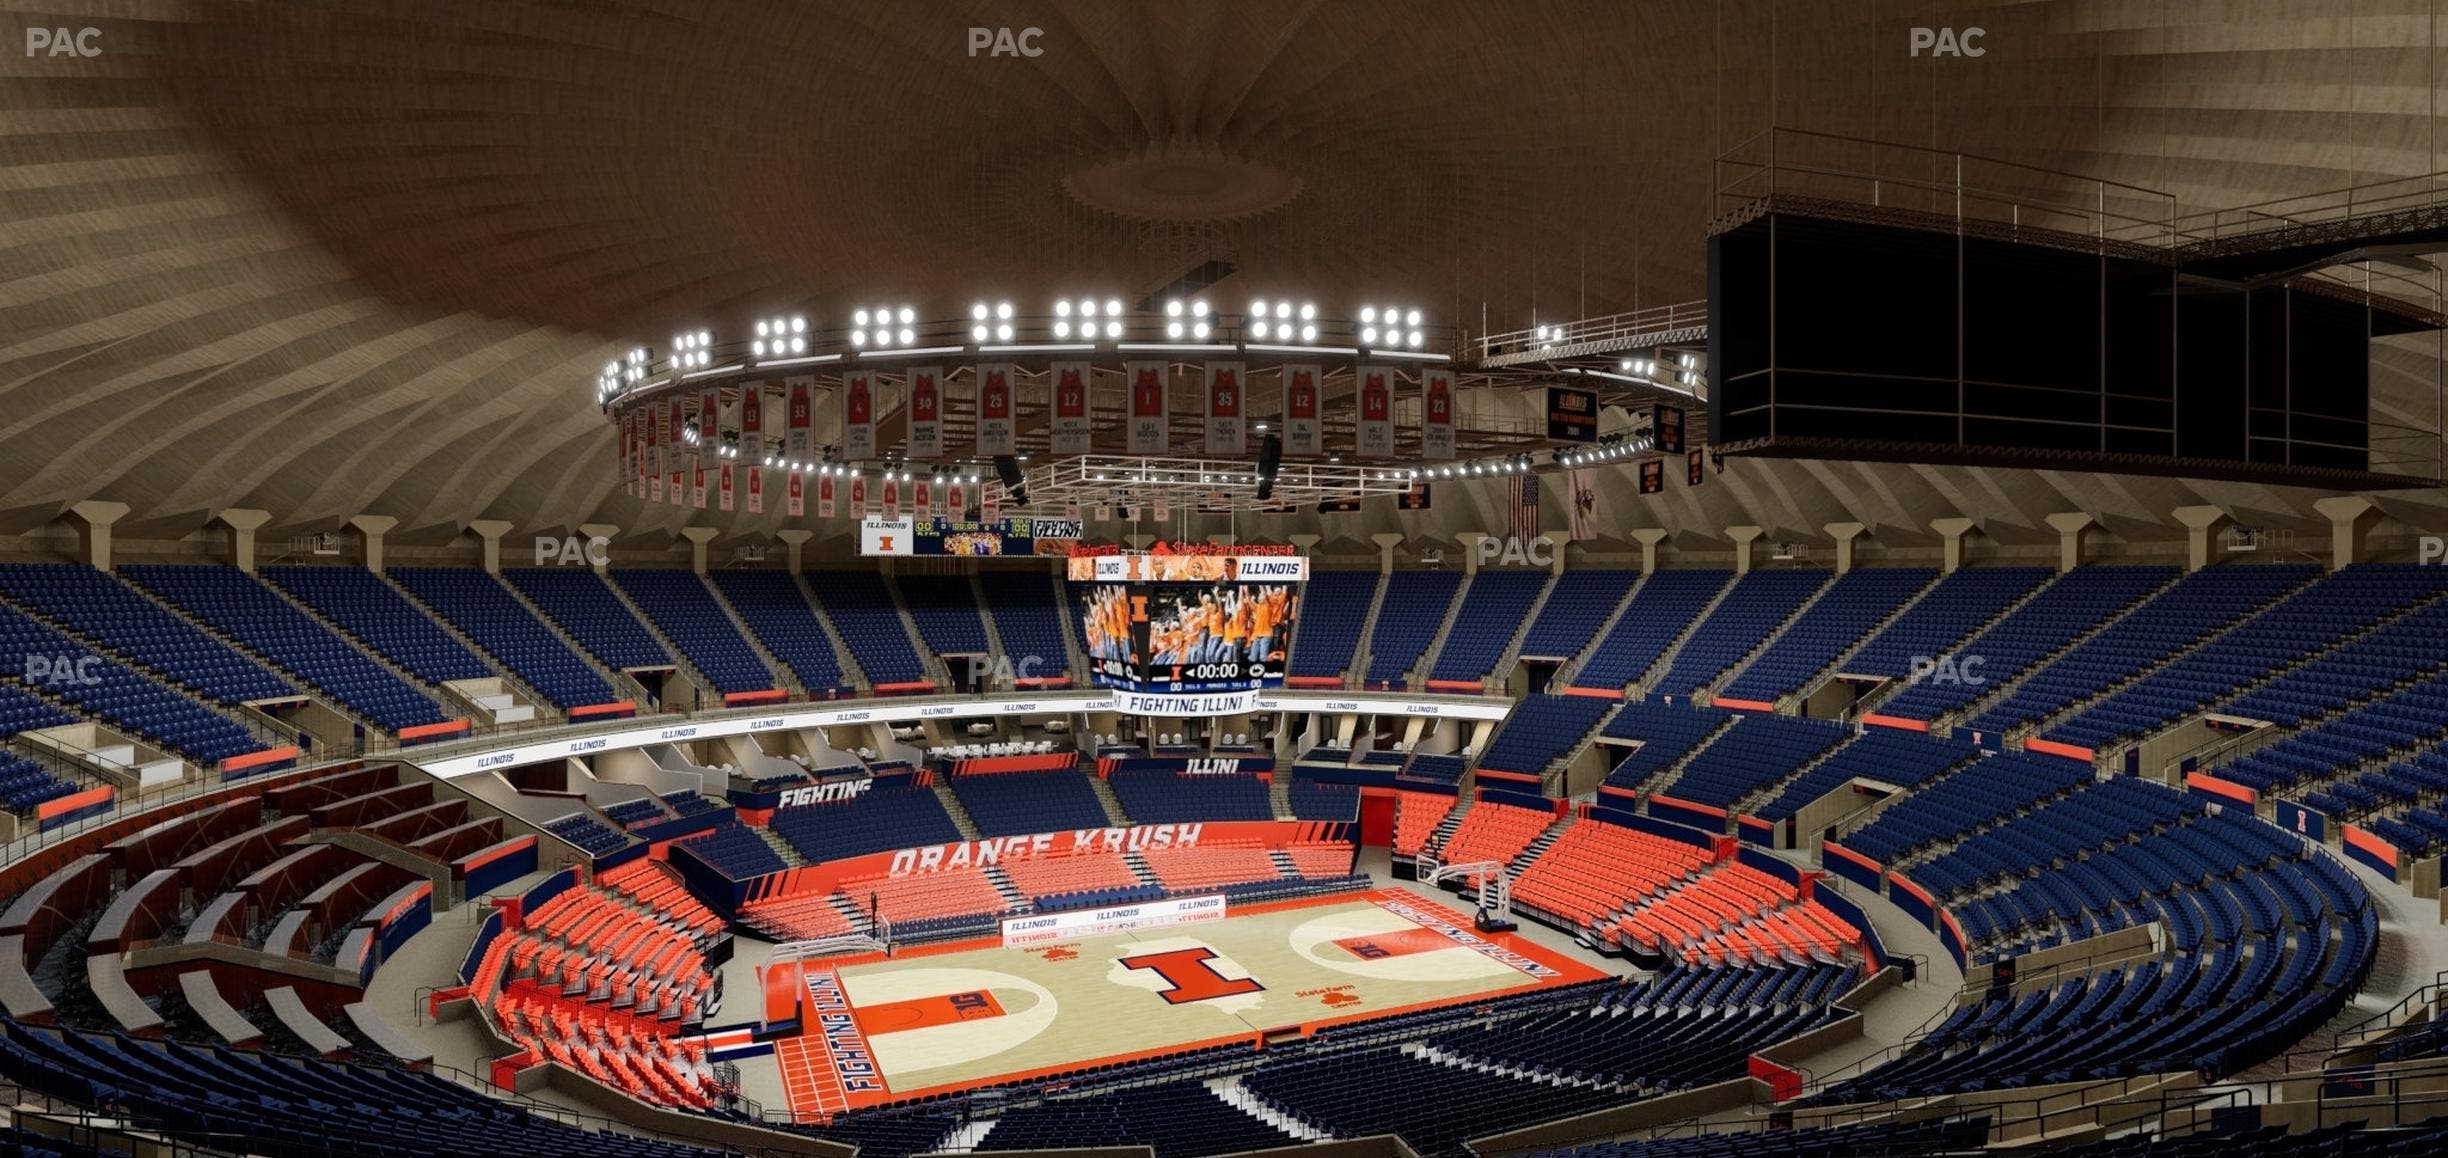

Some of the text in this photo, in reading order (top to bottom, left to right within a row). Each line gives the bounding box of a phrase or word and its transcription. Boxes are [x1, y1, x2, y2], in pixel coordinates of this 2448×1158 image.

[1064, 393, 1078, 406] 12
[1296, 395, 1309, 407] 12
[1369, 398, 1382, 410] 14
[1036, 520, 1081, 529] FIGHTING
[1034, 528, 1081, 537] ILLINI
[1241, 563, 1299, 574] ILLINOIS
[1197, 664, 1238, 678] 00:00
[1250, 680, 1262, 688] 00
[1004, 703, 1036, 711] ILLINOIS
[1130, 696, 1243, 712] FIGHTING ILLINI
[1326, 703, 1357, 711] ILLINOIS
[1406, 705, 1438, 713] ILLINOIS
[837, 711, 870, 722] ILLINOIS
[921, 707, 954, 716] ILLINOIS
[750, 718, 784, 729] ILLINOIS
[661, 727, 696, 740] ILLINOIS
[570, 739, 607, 752] ILLINOIS
[477, 753, 515, 768] ILLINOIS
[1186, 759, 1240, 774] ILLINI
[889, 823, 1203, 879] ORANGE KRUSH
[1179, 899, 1219, 911] ILLINOIS
[1097, 908, 1140, 920] ILLINOIS
[1011, 918, 1057, 931] ILLINOIS
[803, 973, 848, 1012] ILLINI
[819, 1013, 884, 1093] FIGHTING
